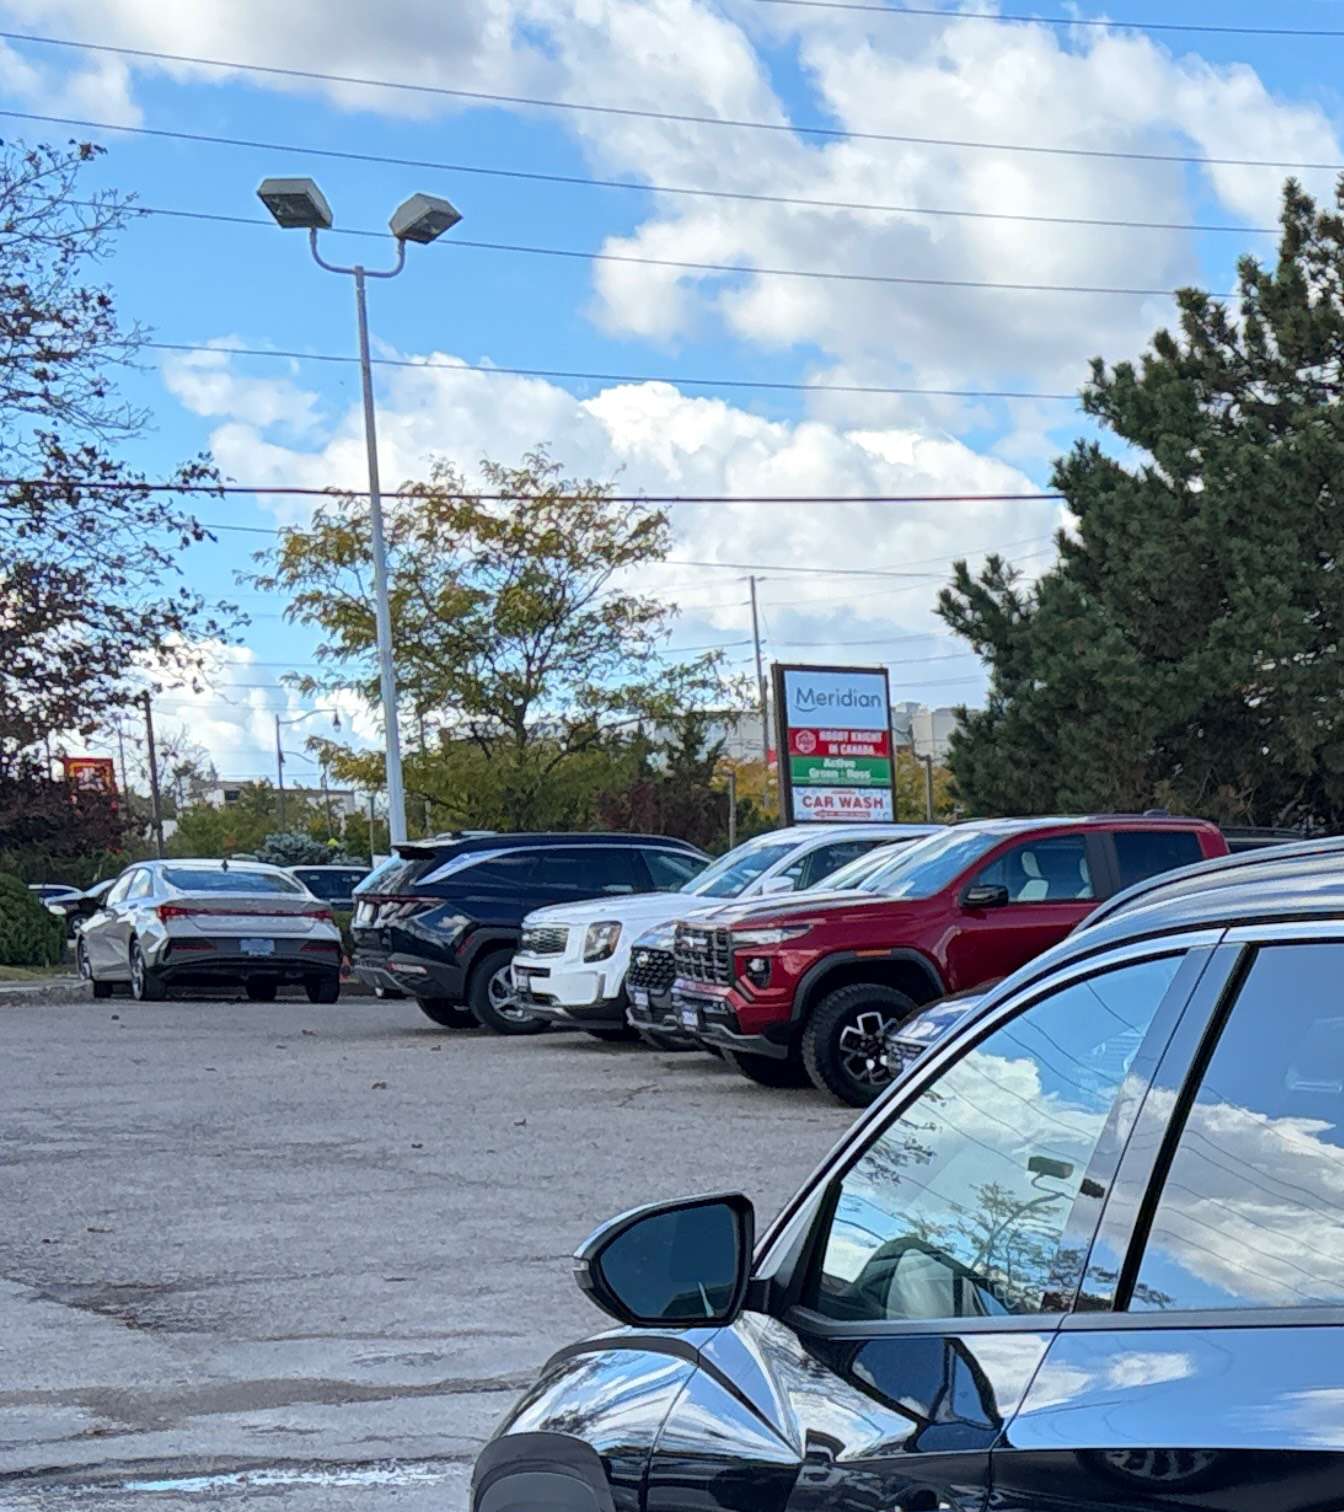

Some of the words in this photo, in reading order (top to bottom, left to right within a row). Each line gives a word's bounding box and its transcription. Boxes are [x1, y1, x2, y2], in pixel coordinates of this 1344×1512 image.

[796, 686, 882, 709] Meridian
[802, 796, 834, 809] CAR
[839, 796, 884, 810] WASH
